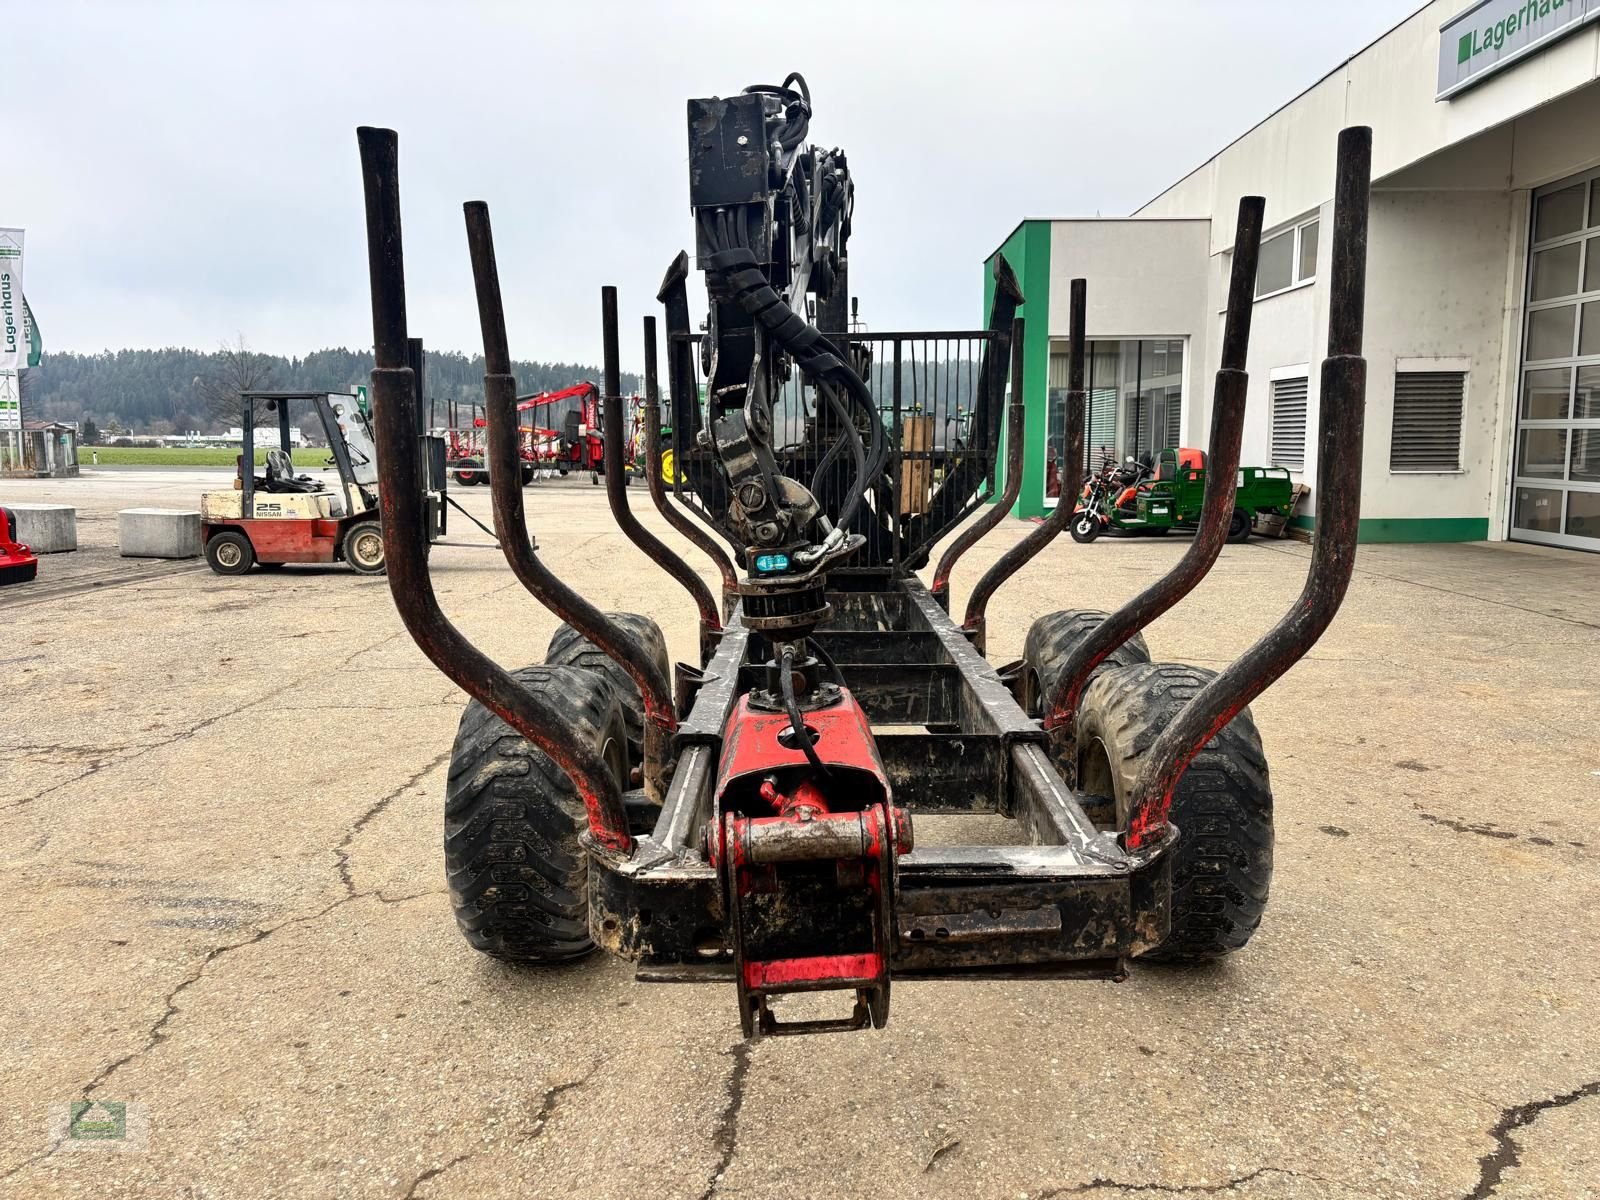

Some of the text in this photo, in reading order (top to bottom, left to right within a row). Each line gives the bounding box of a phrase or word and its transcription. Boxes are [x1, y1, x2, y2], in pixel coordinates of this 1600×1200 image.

[1472, 0, 1571, 56] Lagerhau
[0, 273, 16, 353] Lagerhaus
[256, 503, 281, 511] 25
